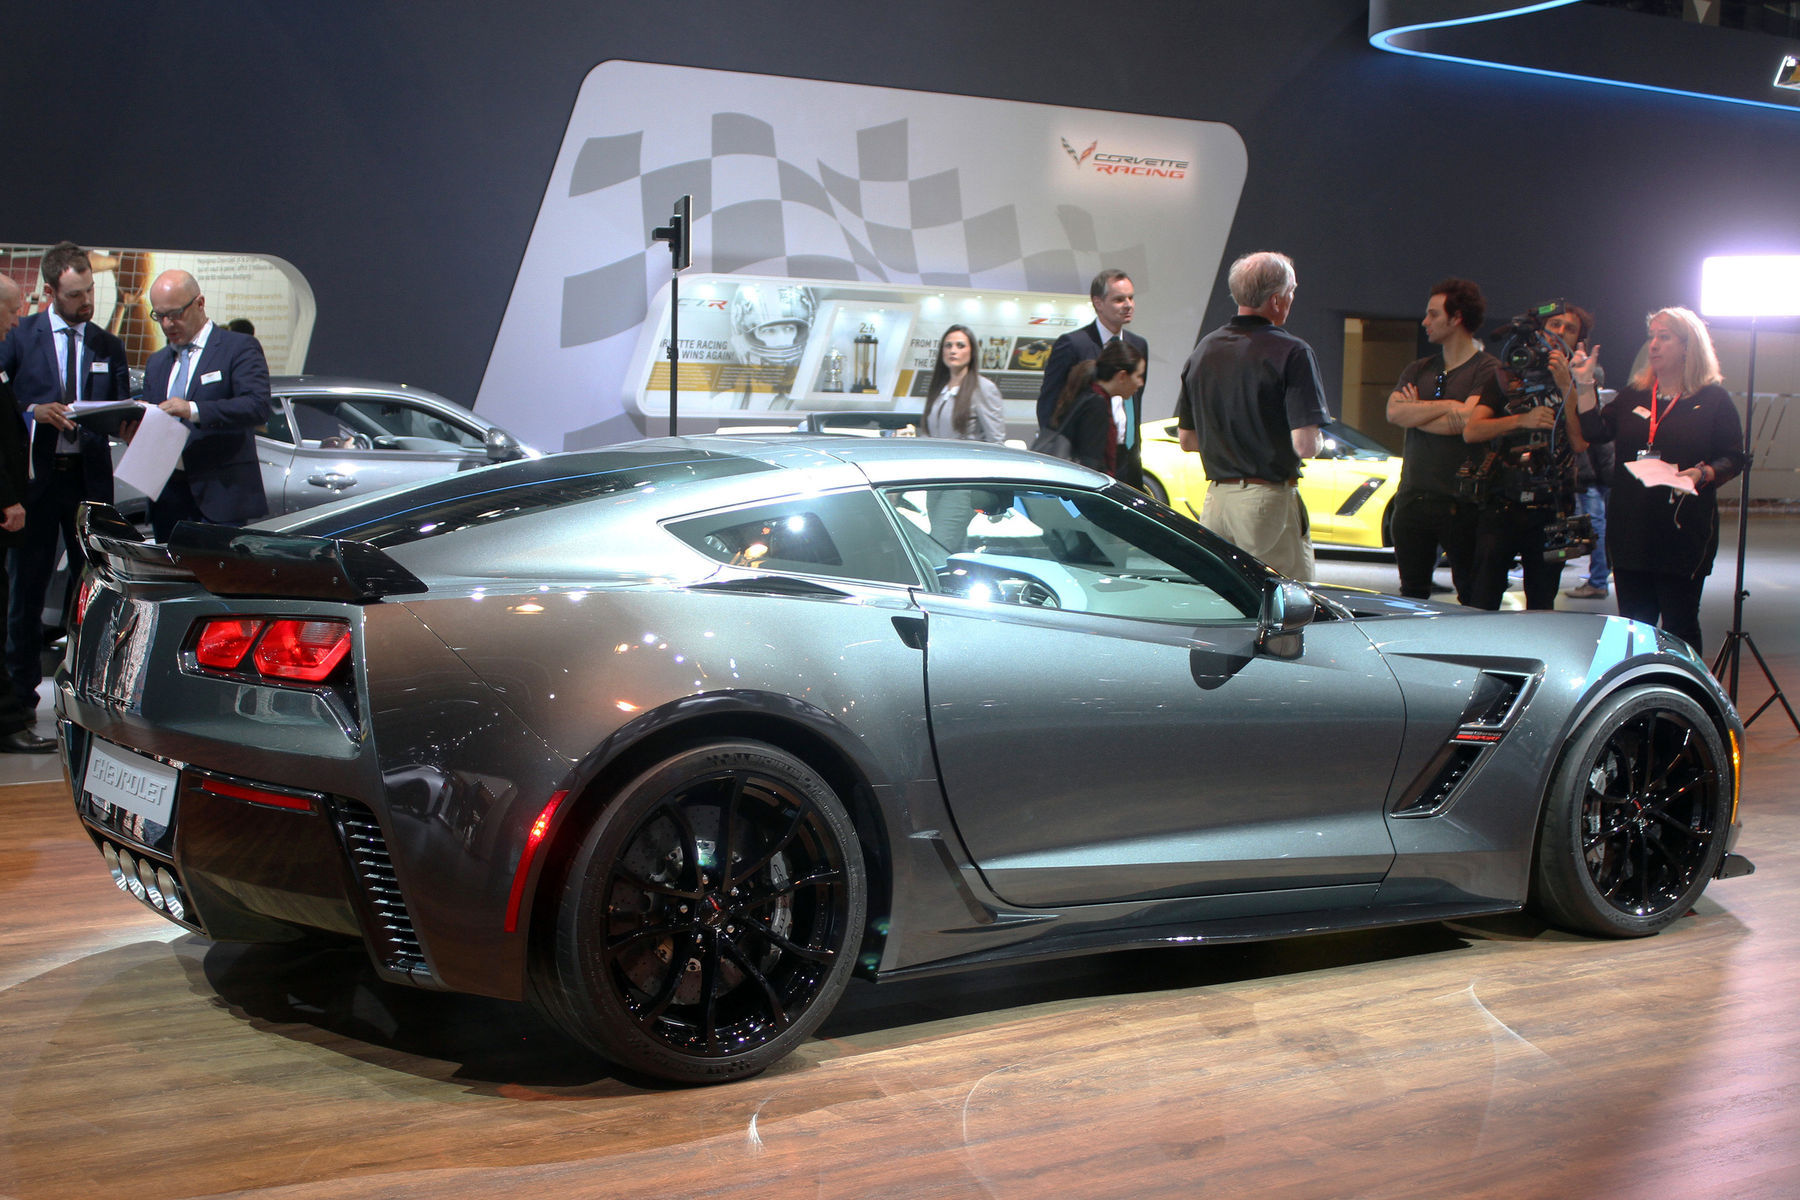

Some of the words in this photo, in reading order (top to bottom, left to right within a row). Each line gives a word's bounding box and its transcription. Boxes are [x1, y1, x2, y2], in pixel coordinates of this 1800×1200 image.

[1094, 153, 1190, 169] CORVETTE
[1092, 163, 1186, 179] RACING
[697, 340, 729, 350] RACING
[910, 338, 932, 348] FROM
[681, 350, 705, 360] WINS
[706, 351, 736, 361] AGAIN!
[914, 358, 929, 368] THE
[92, 758, 168, 806] CHEVROLET
